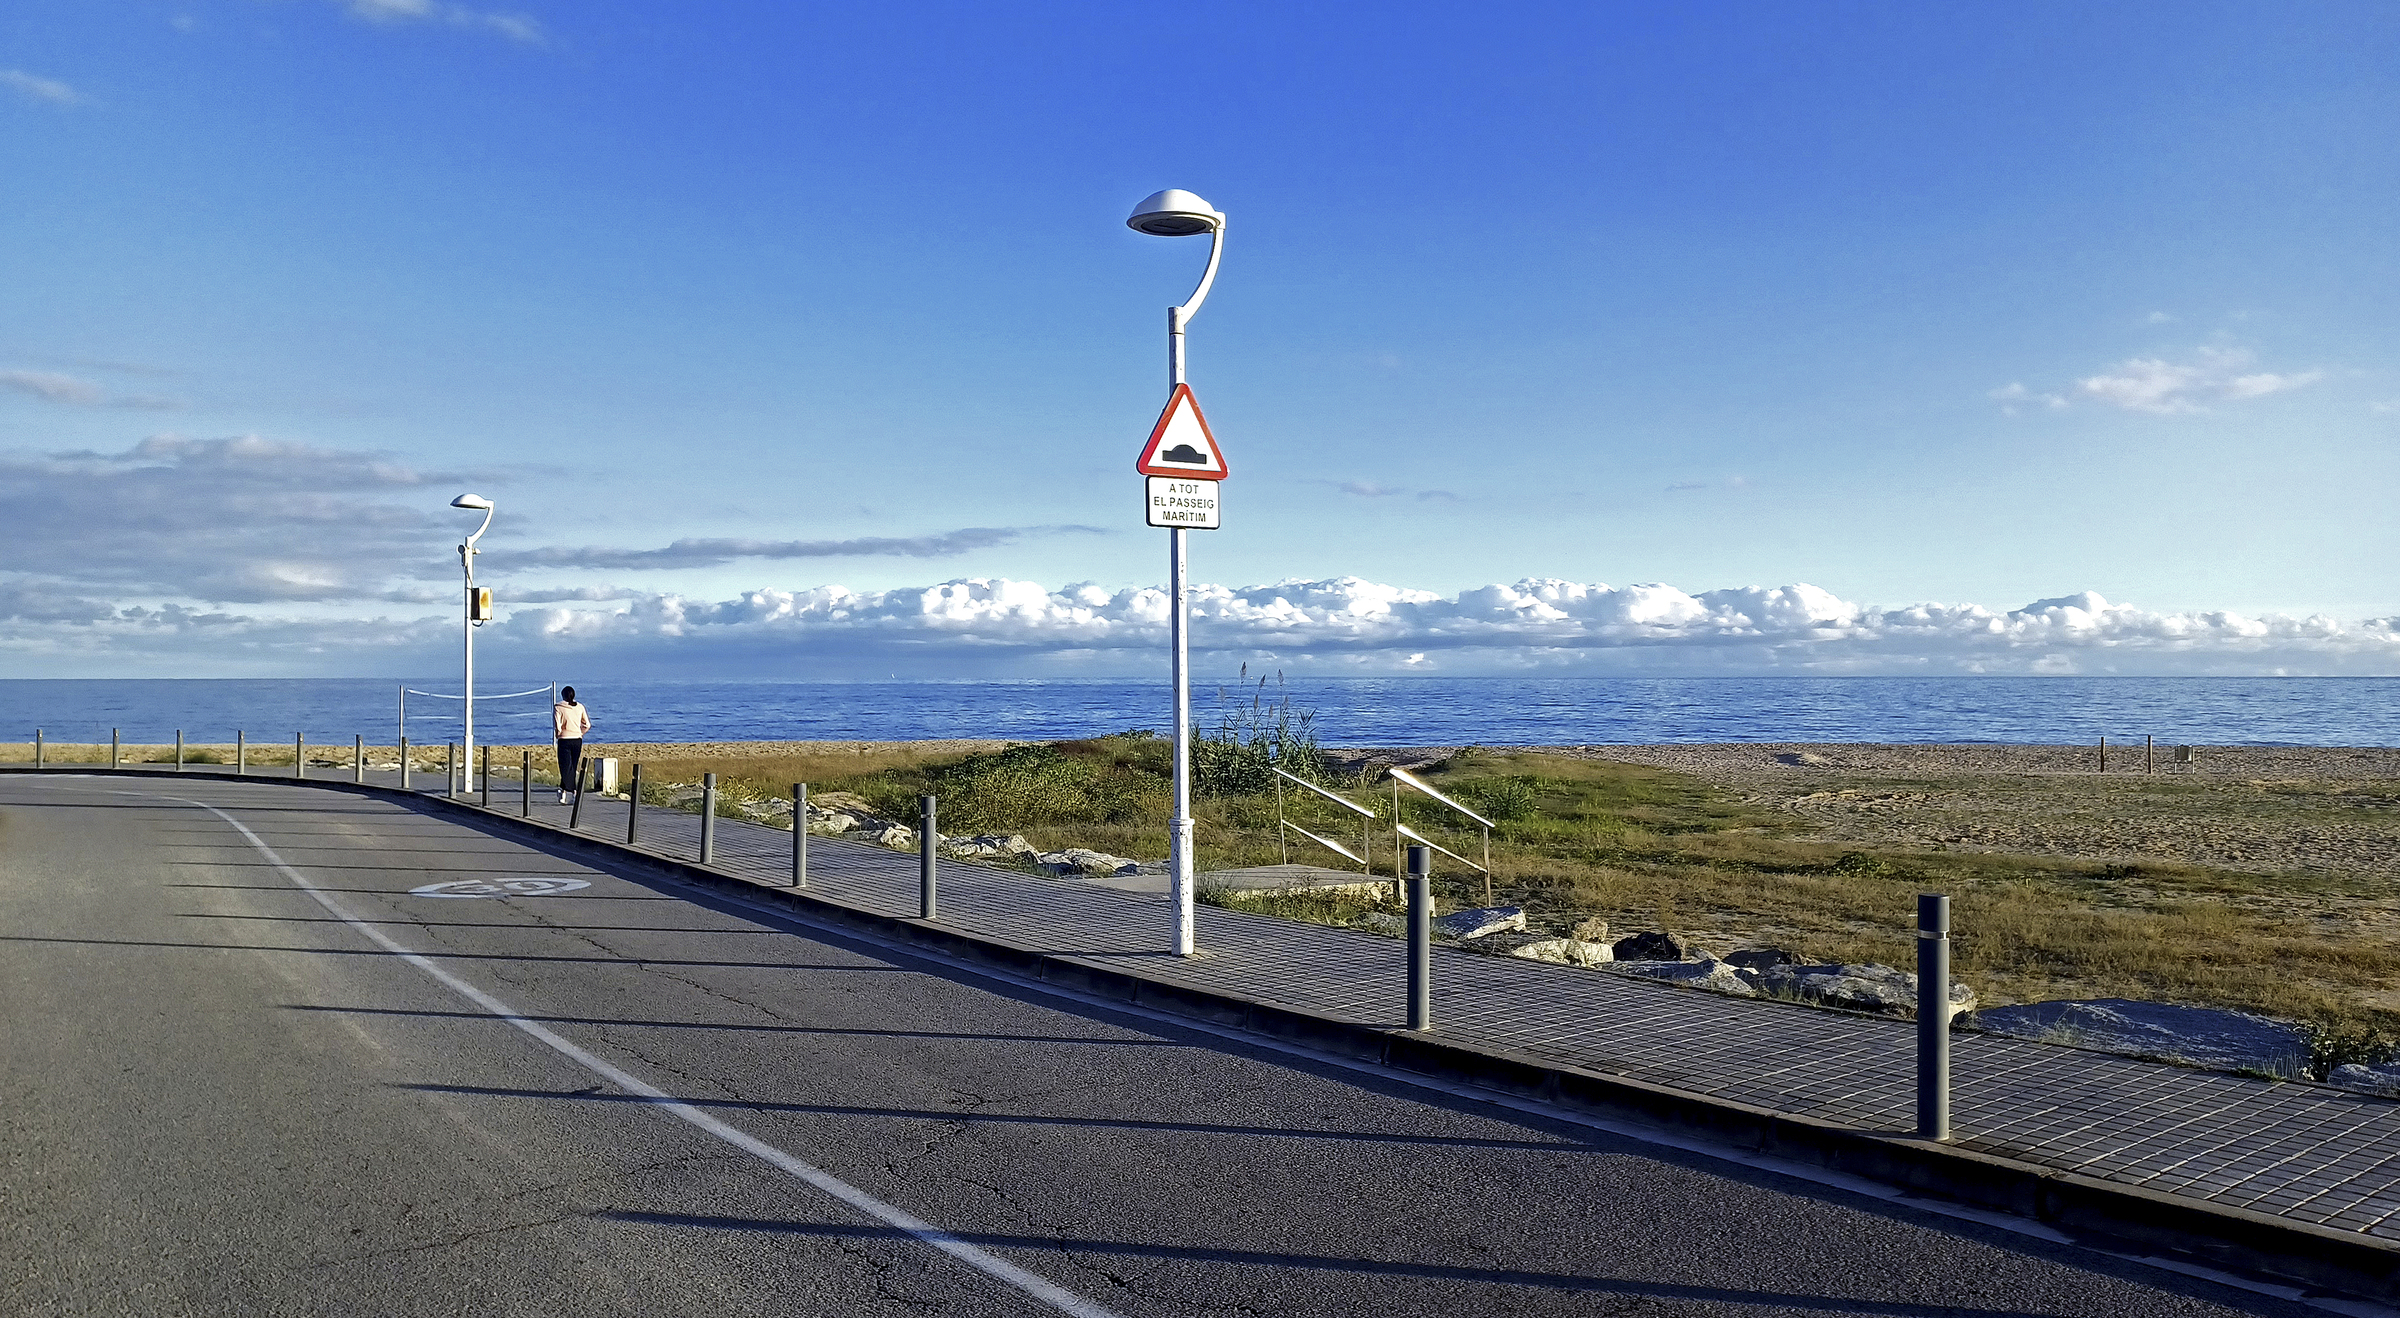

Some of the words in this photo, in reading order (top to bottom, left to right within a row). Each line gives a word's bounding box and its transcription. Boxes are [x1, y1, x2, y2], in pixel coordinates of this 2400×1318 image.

[1169, 483, 1177, 493] A
[1178, 483, 1199, 494] TOT
[1153, 496, 1167, 507] EL
[1169, 497, 1214, 509] PASSEIG
[1162, 510, 1206, 522] MARÍTIM
